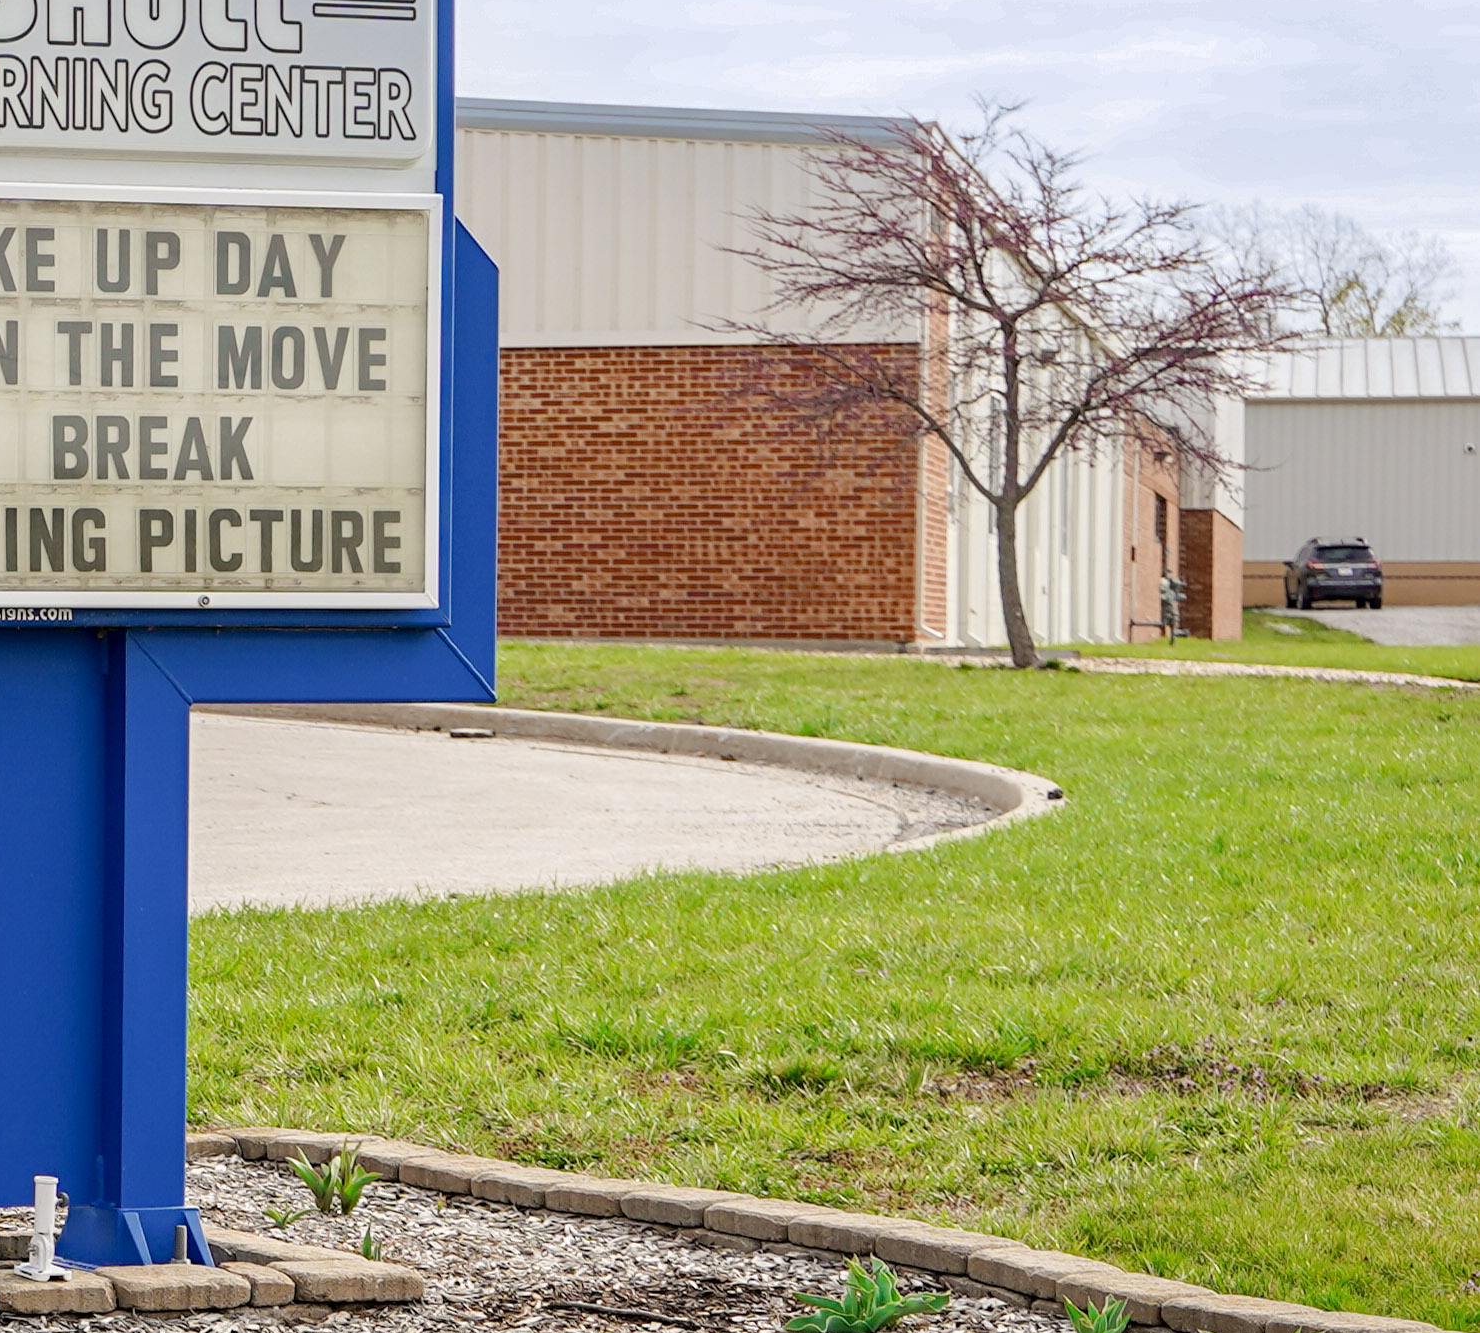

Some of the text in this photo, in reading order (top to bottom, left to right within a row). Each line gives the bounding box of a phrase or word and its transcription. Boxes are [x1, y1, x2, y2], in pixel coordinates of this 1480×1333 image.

[188, 60, 418, 141] CENTER
[96, 228, 181, 296] UP
[216, 231, 346, 298] DAY
[57, 321, 178, 388] THE
[218, 325, 386, 391] MOVE
[52, 415, 254, 481] BREAK
[139, 508, 401, 574] PICTURE
